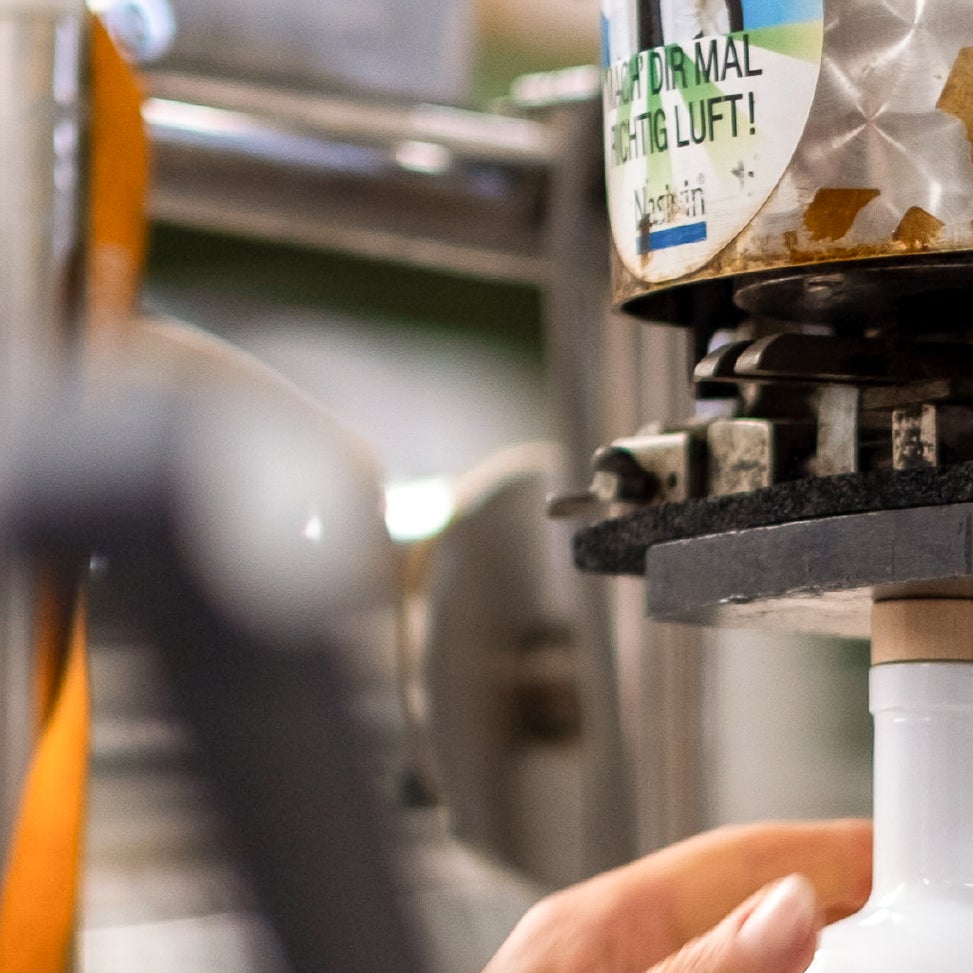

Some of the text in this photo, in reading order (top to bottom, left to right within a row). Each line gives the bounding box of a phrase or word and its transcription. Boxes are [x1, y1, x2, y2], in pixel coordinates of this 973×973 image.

[650, 46, 688, 95] DIR
[694, 34, 763, 86] MAL
[674, 92, 756, 148] LUFT!
